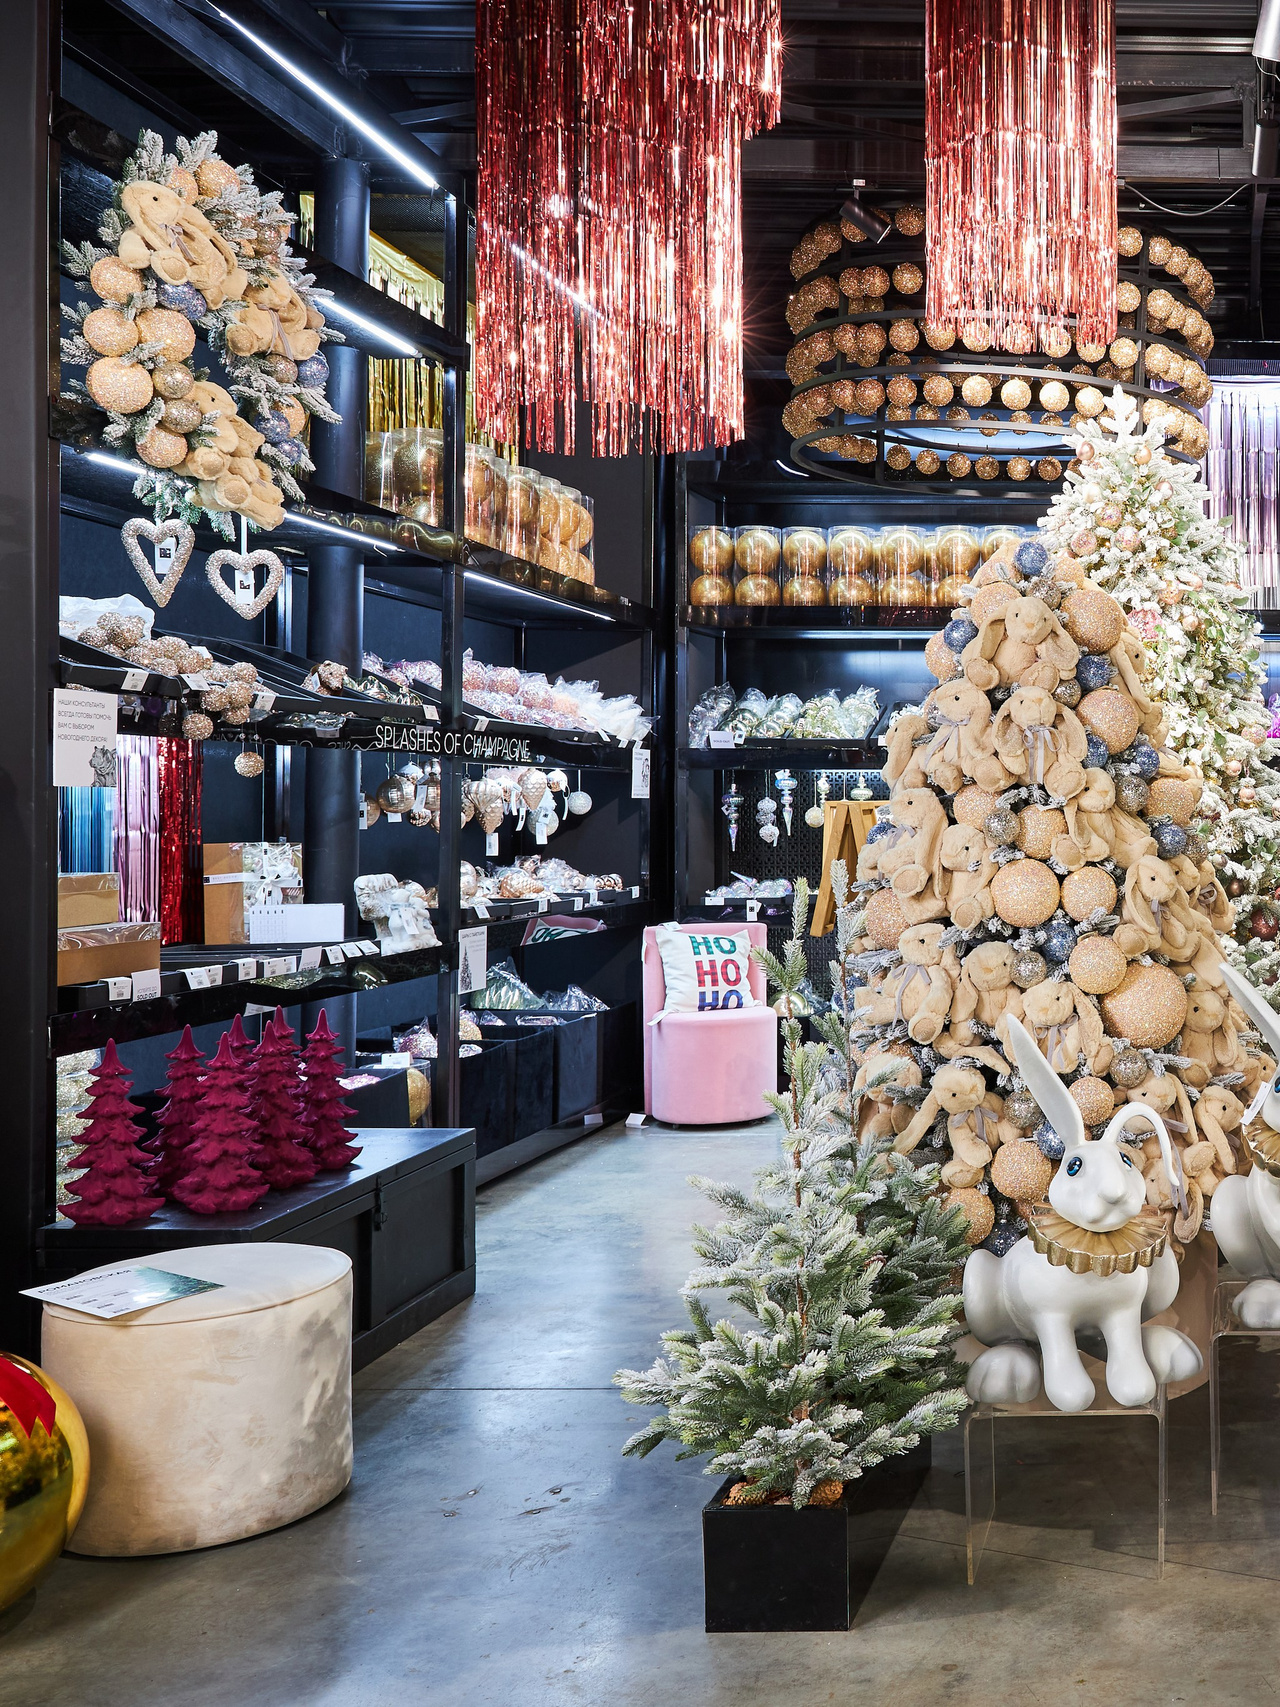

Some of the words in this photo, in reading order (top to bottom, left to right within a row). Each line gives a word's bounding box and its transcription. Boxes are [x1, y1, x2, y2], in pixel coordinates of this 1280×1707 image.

[375, 724, 441, 754] SPLASHES
[444, 733, 462, 754] OF
[463, 734, 531, 760] CHAMPAGNE
[688, 935, 737, 956] HO
[695, 958, 742, 988] HO
[697, 989, 744, 1012] HO
